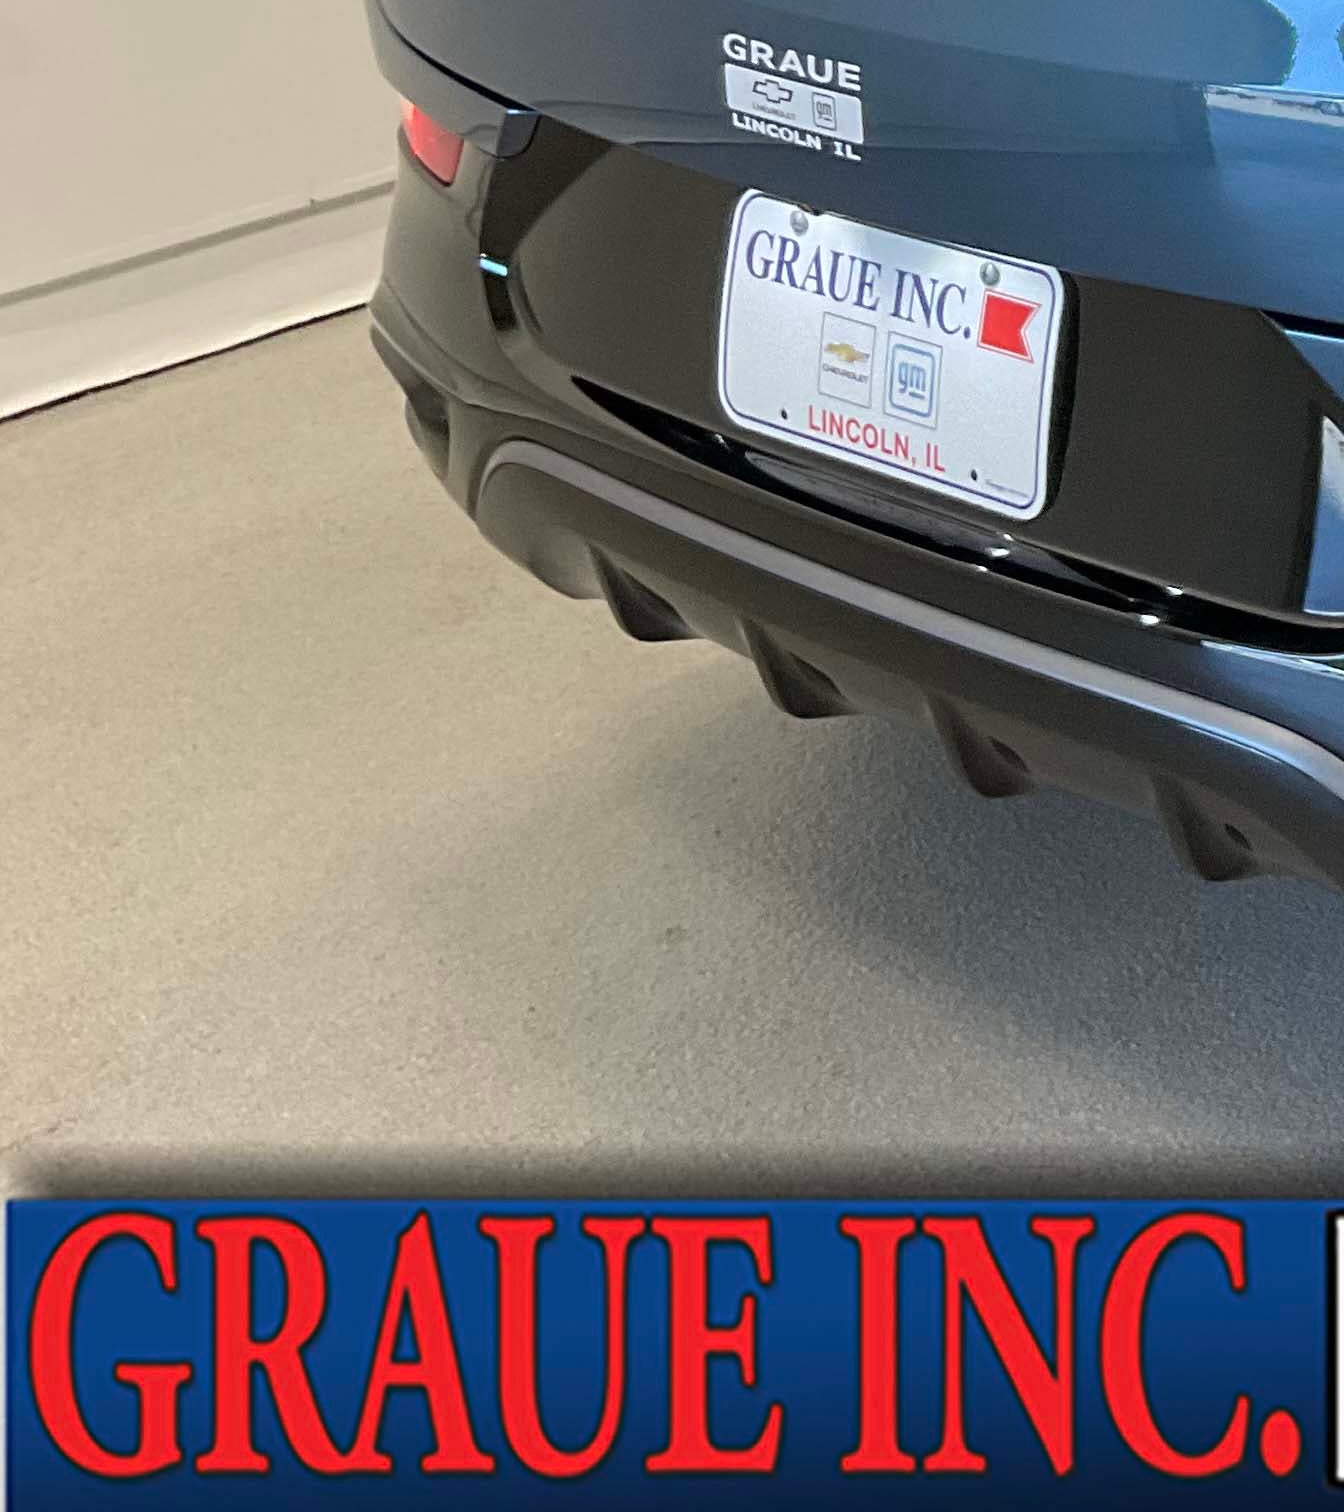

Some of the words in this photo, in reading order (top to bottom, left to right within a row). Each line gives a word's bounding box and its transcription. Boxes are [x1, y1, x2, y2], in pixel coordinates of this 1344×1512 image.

[722, 32, 862, 92] GRAUE
[731, 112, 822, 151] LINCOLN
[833, 141, 862, 162] IL
[746, 229, 882, 312] GRAUE
[890, 268, 972, 340] INC.
[898, 362, 926, 394] gm
[808, 404, 917, 466] LINCOLN,
[925, 441, 946, 473] IL
